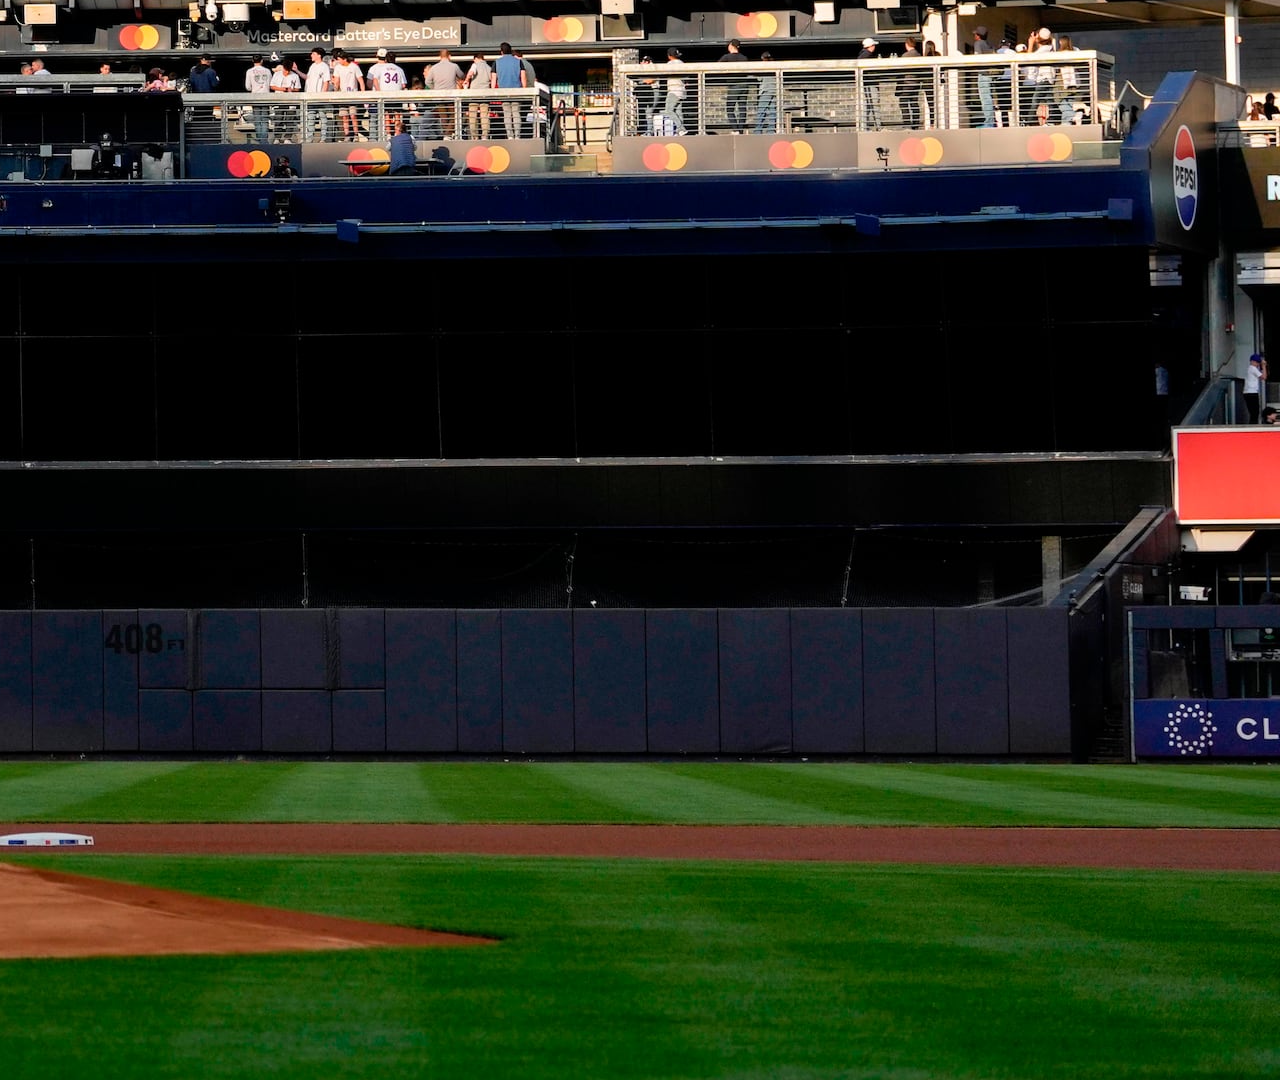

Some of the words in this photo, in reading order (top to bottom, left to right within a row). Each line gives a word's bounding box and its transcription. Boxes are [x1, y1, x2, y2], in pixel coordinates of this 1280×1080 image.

[247, 28, 331, 43] Mastercard
[336, 28, 391, 41] Batter's
[393, 27, 421, 43] Eye
[422, 26, 458, 40] Deck
[384, 72, 399, 84] 34
[1175, 165, 1197, 190] PEPSI
[104, 623, 164, 654] 408
